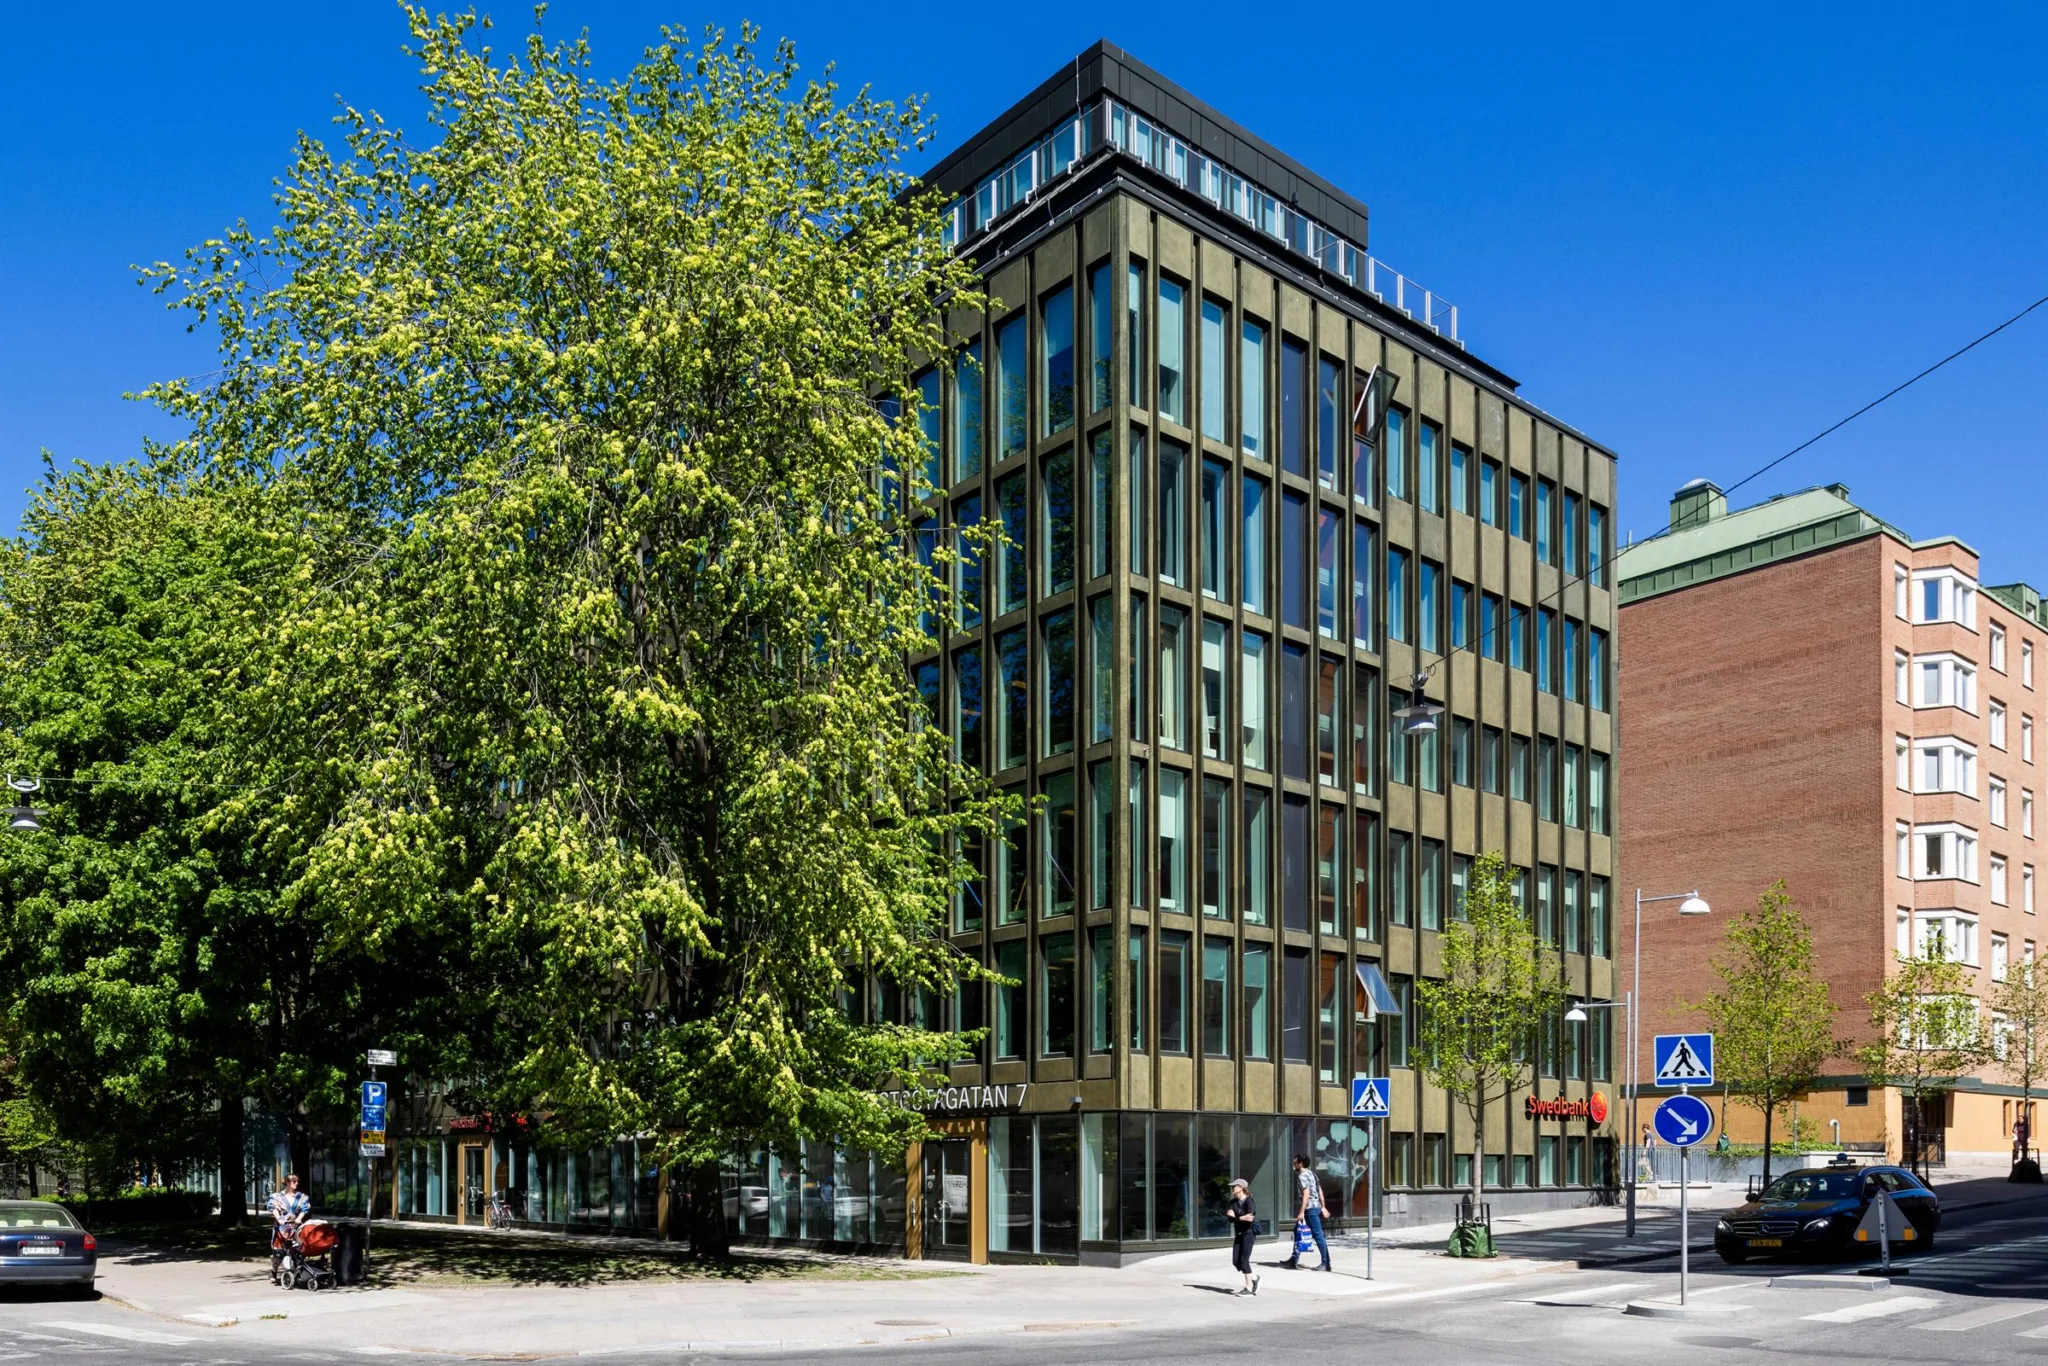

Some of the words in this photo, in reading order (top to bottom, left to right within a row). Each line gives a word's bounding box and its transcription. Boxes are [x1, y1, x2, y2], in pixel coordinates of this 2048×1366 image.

[368, 1084, 383, 1104] P
[870, 1084, 1008, 1112] STGÖTAGATAN
[1016, 1083, 1028, 1107] 7
[1529, 1094, 1590, 1116] Swedbank
